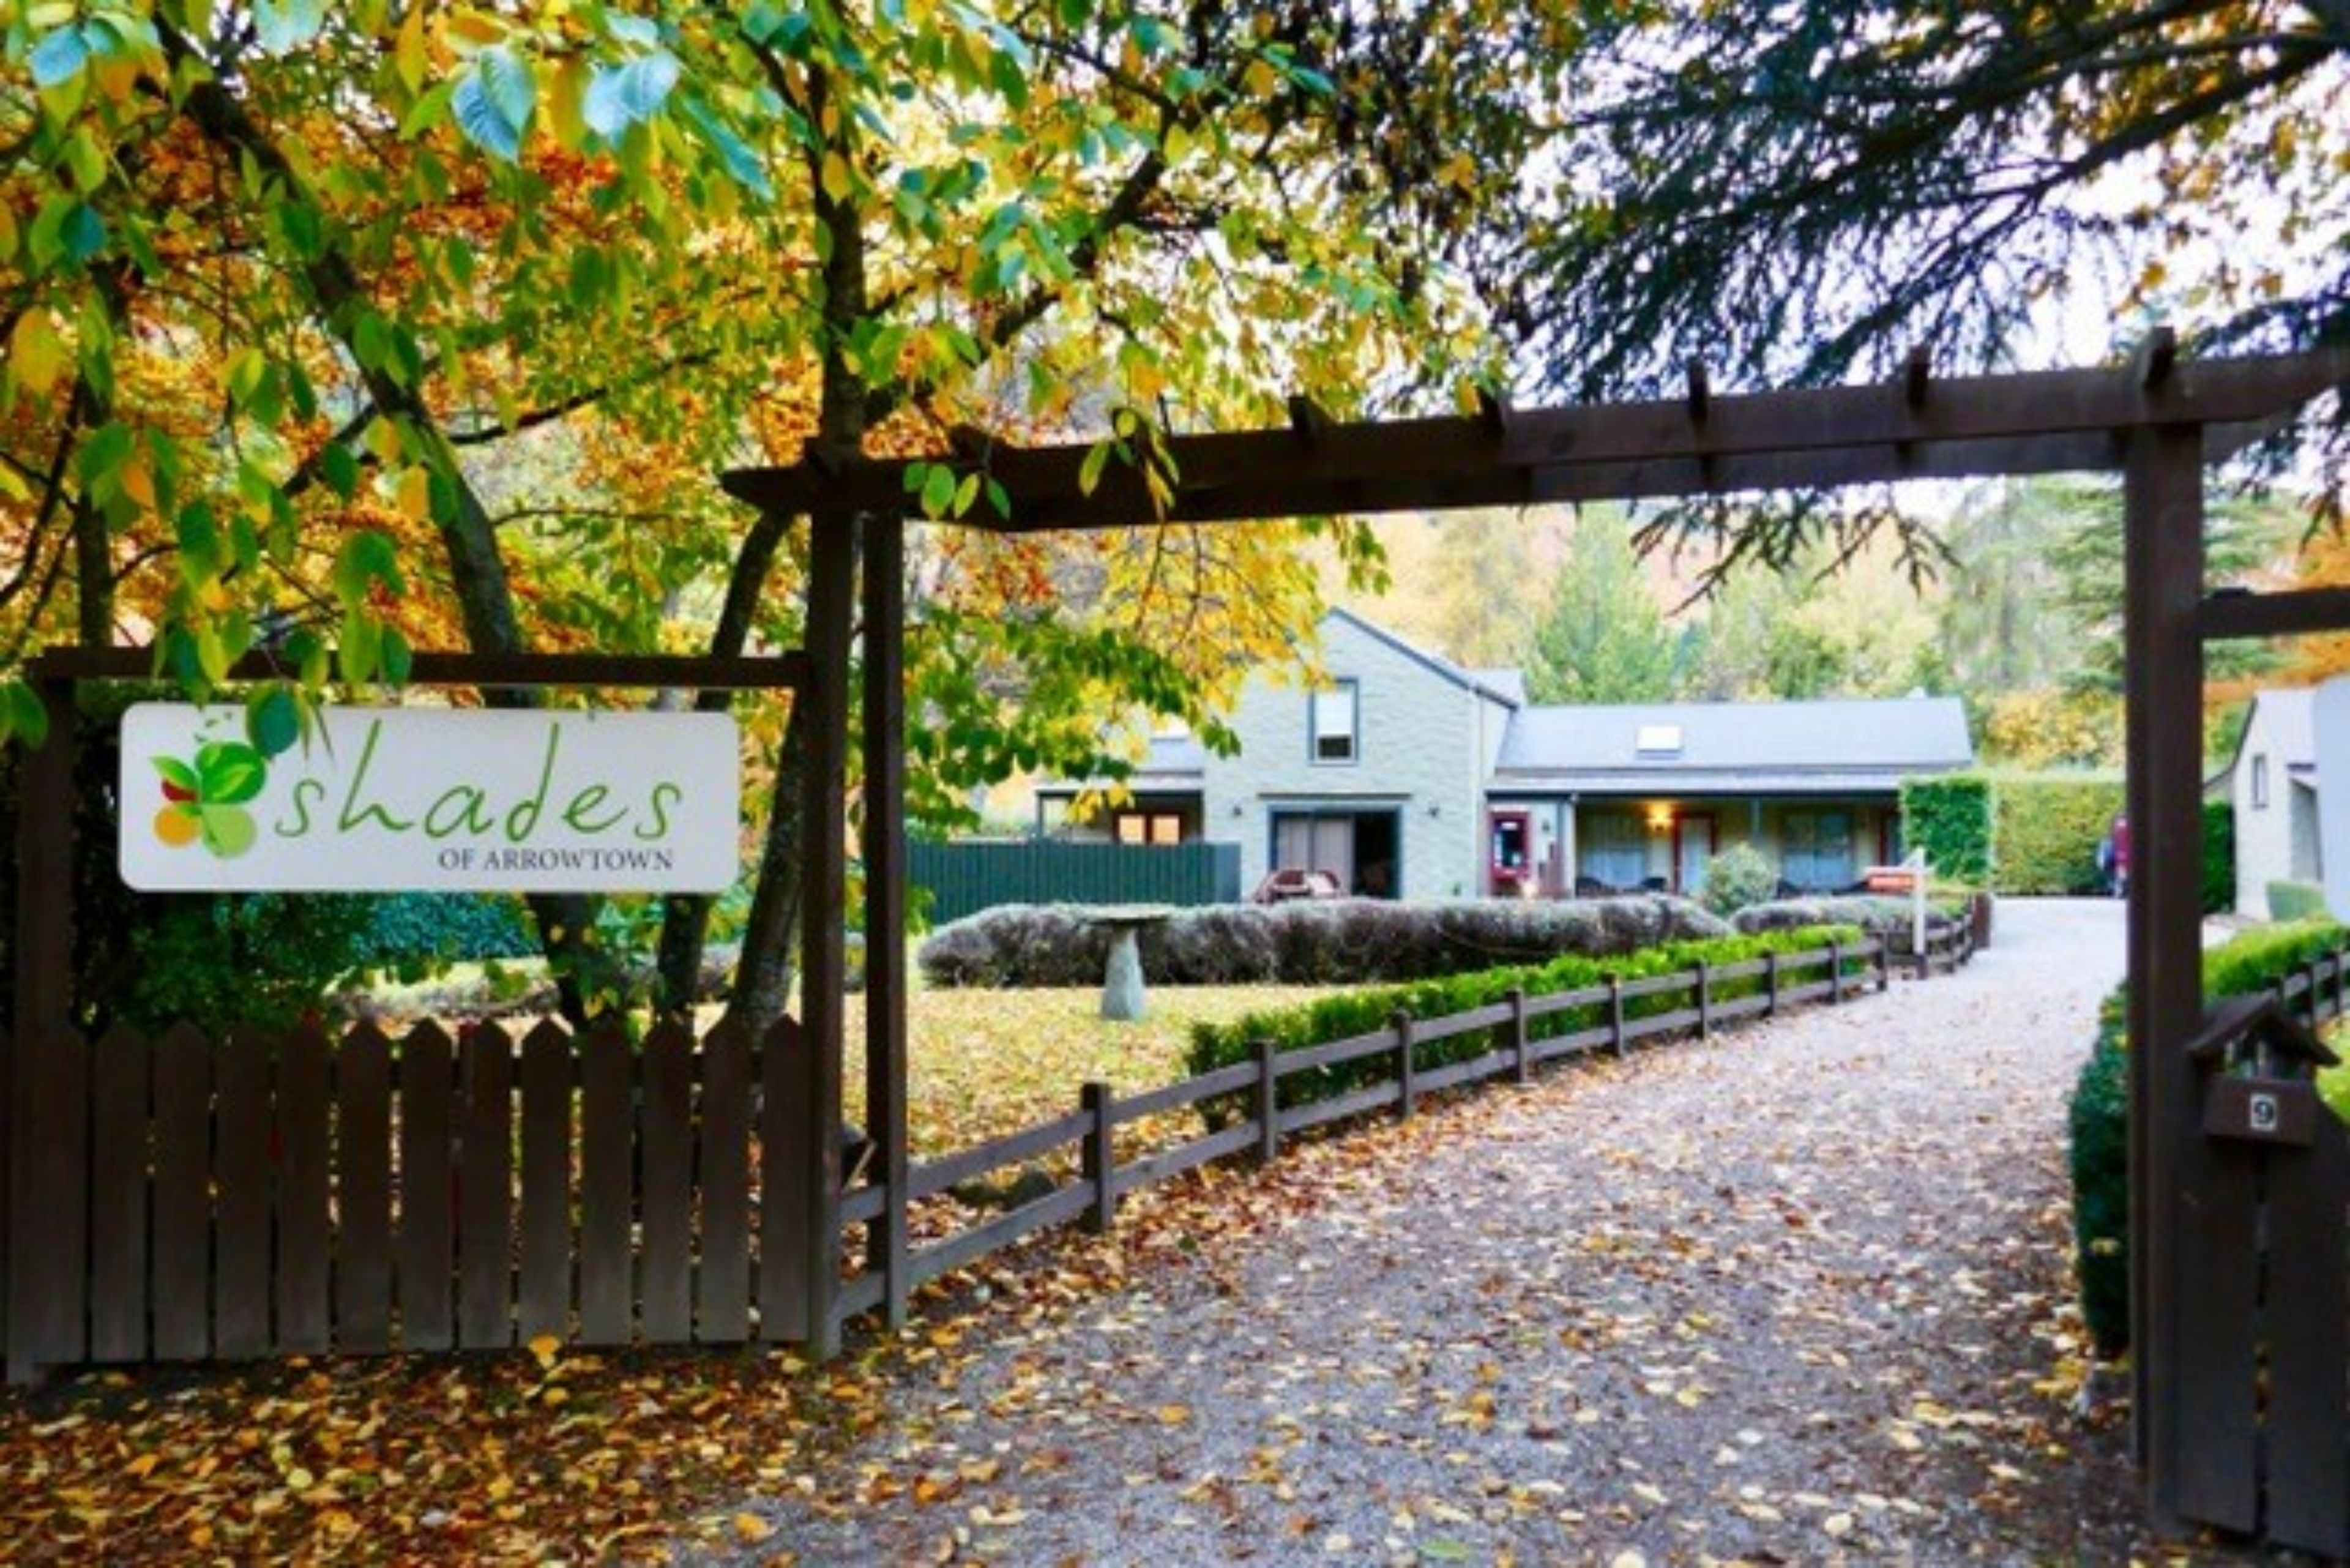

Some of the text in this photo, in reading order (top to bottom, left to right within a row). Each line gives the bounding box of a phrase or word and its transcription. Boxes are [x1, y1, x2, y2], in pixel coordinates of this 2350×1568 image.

[275, 719, 682, 842] shades
[438, 848, 674, 871] OF ARROWTOWN
[2254, 1101, 2274, 1124] 9
